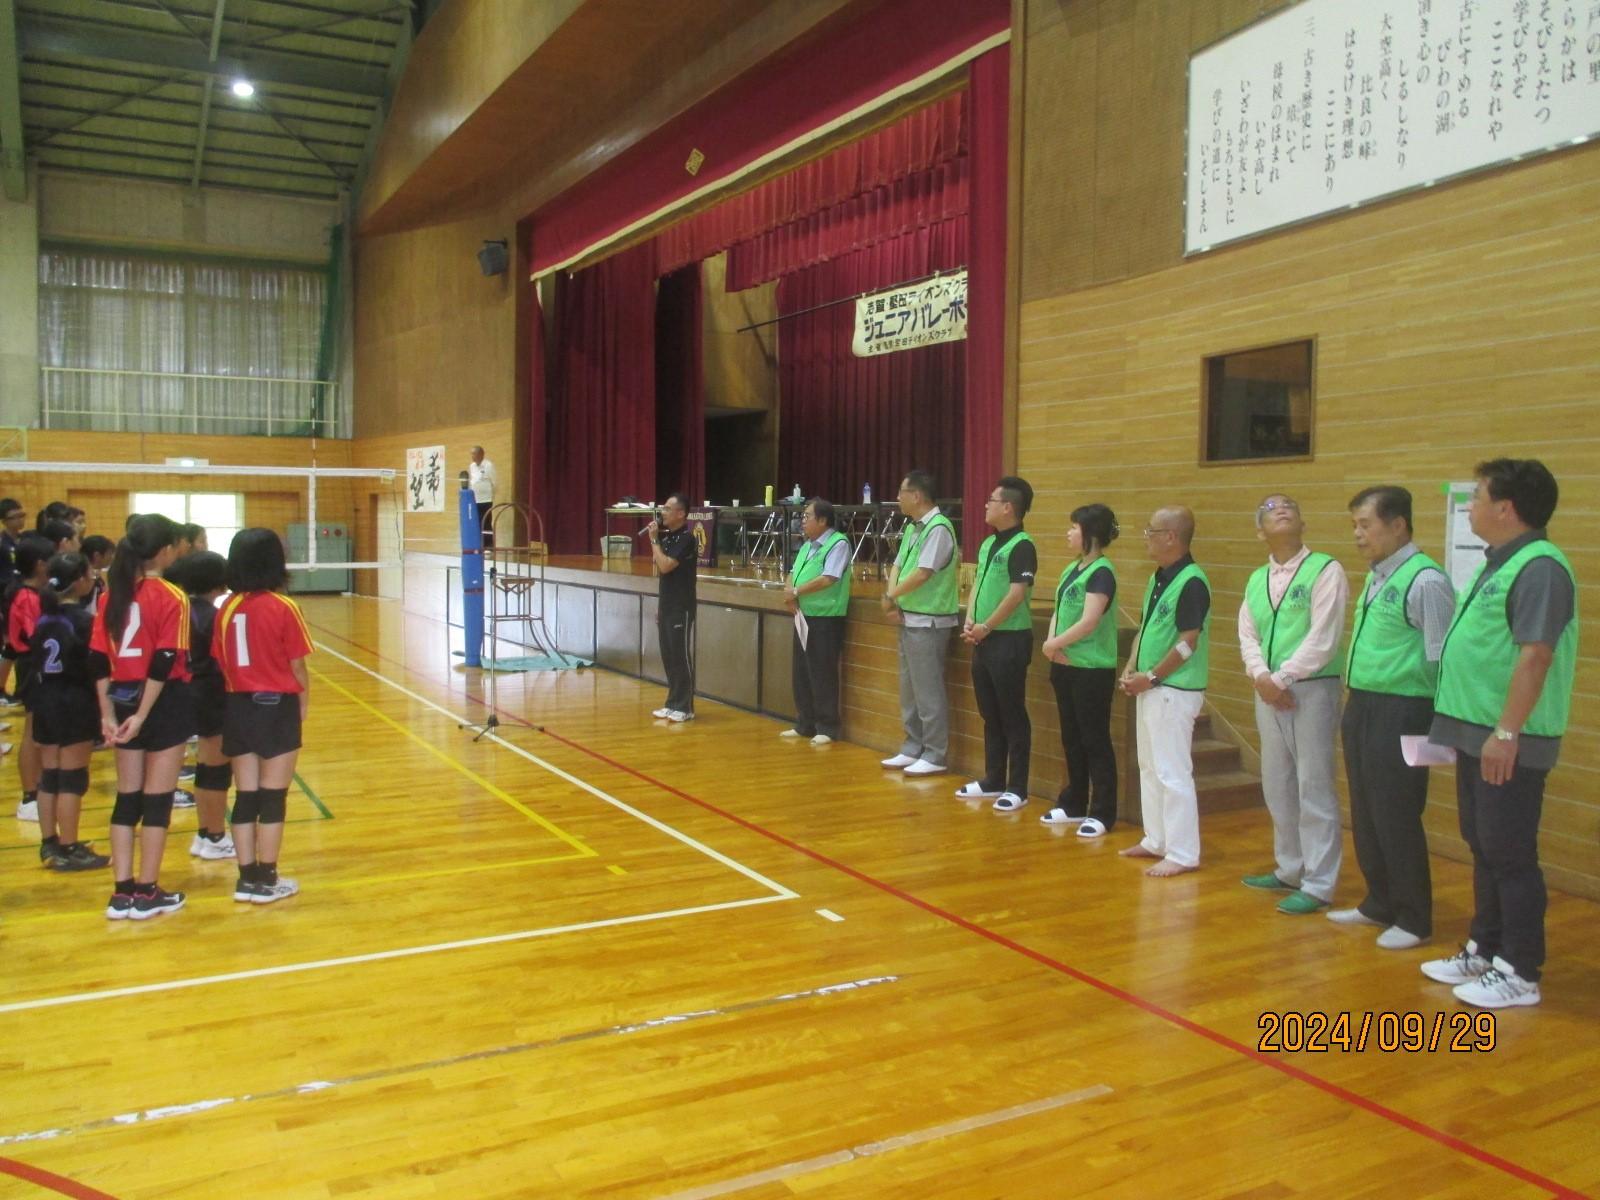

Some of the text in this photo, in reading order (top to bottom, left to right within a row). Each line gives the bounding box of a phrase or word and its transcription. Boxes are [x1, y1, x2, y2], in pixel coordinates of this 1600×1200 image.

[1342, 28, 1356, 160] はるけき理想
[1396, 60, 1409, 170] しるしなり
[1488, 20, 1503, 142] ここなれや
[1324, 89, 1336, 194] ここにあり
[863, 295, 968, 343] ジュニアバレーボ
[43, 638, 63, 673] 2
[118, 601, 143, 658] 2
[232, 613, 251, 667] 1
